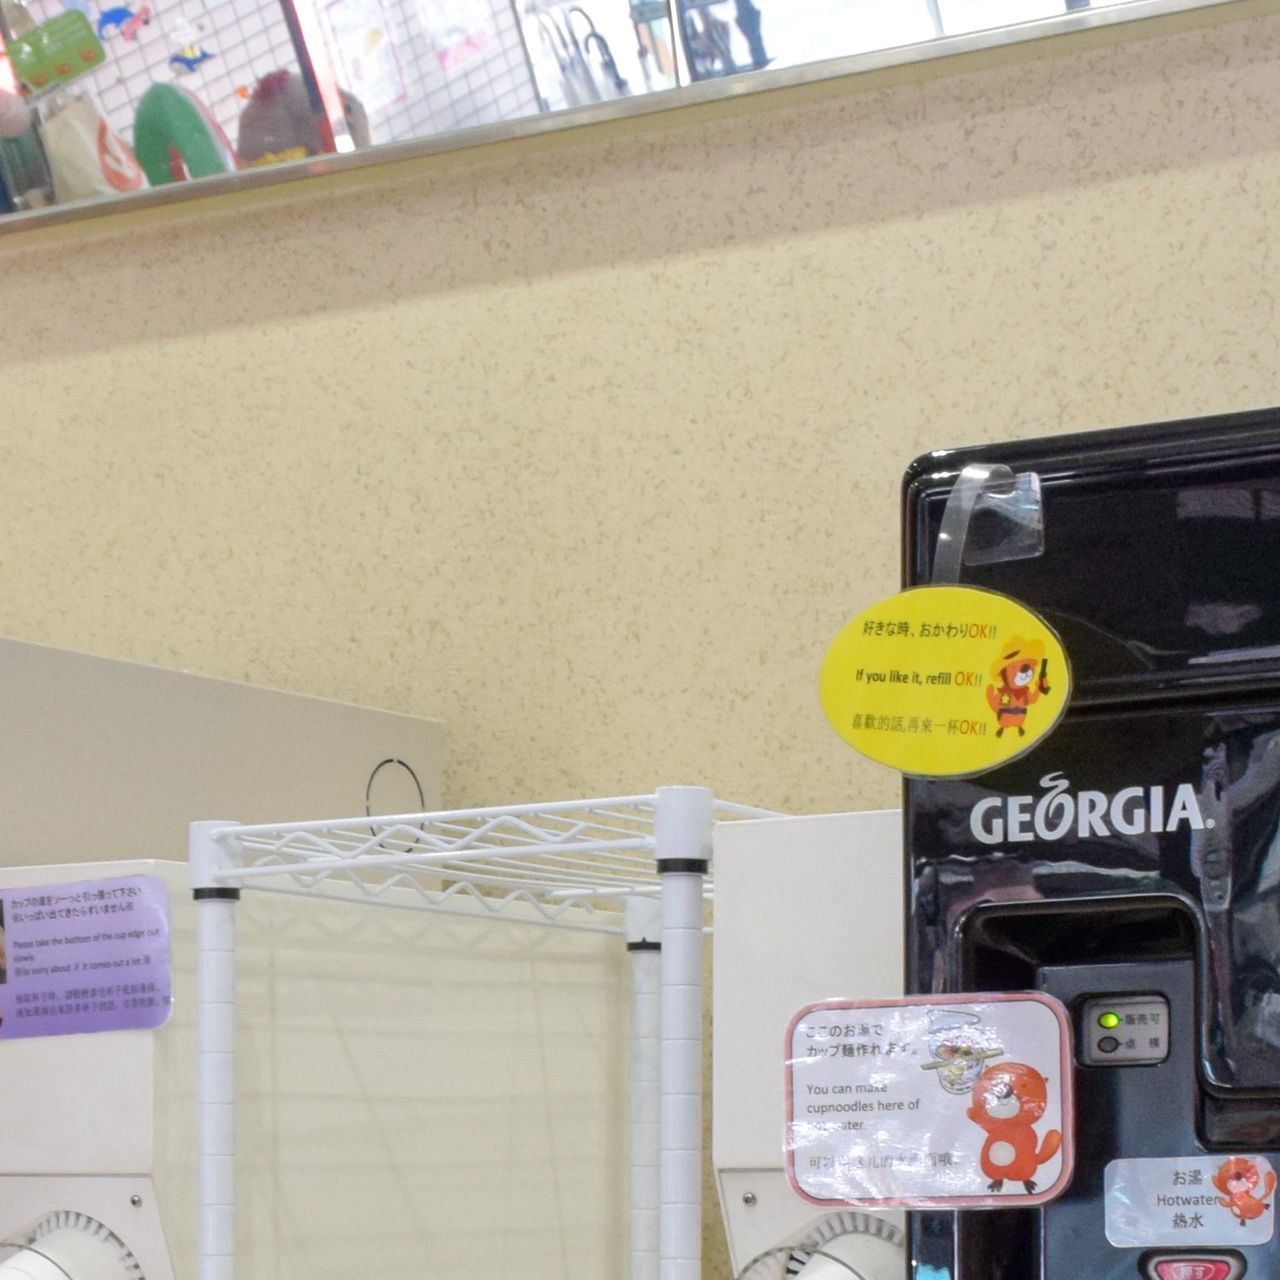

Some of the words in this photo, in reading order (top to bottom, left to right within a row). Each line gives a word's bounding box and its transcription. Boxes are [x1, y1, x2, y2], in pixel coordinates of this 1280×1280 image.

[862, 620, 997, 640] 好きな時、おかわりOK!!
[856, 669, 864, 681] If
[867, 670, 886, 684] you
[889, 670, 909, 683] like
[926, 672, 951, 685] refill
[954, 673, 982, 688] OK!!
[970, 772, 1205, 844] GEORGIA
[807, 1084, 829, 1095] You
[832, 1085, 852, 1095] can
[807, 1100, 874, 1115] cupnoodles
[877, 1100, 904, 1111] here
[907, 1098, 920, 1111] of
[1173, 1169, 1203, 1185] お湯
[1172, 1212, 1204, 1230] 热水
